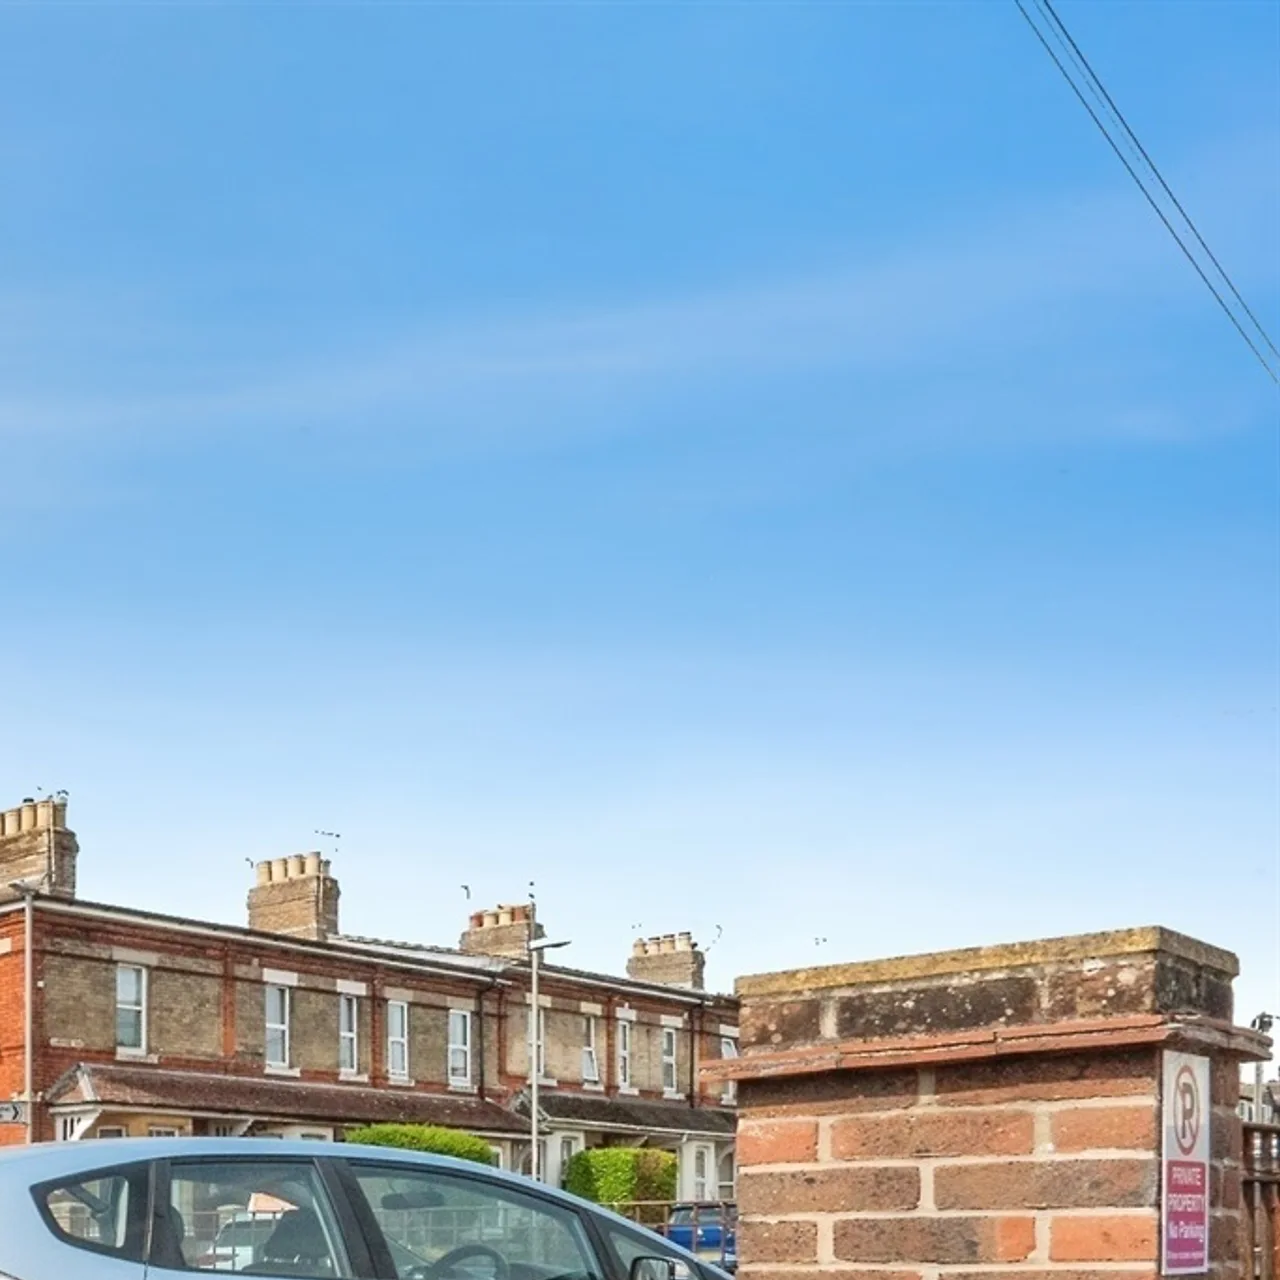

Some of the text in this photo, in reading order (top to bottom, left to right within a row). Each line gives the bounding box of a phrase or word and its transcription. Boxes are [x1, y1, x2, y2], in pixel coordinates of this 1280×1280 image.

[1172, 1166, 1202, 1186] PRIVATE
[1168, 1193, 1205, 1212] PROPERTY
[1168, 1220, 1205, 1243] No Parking
